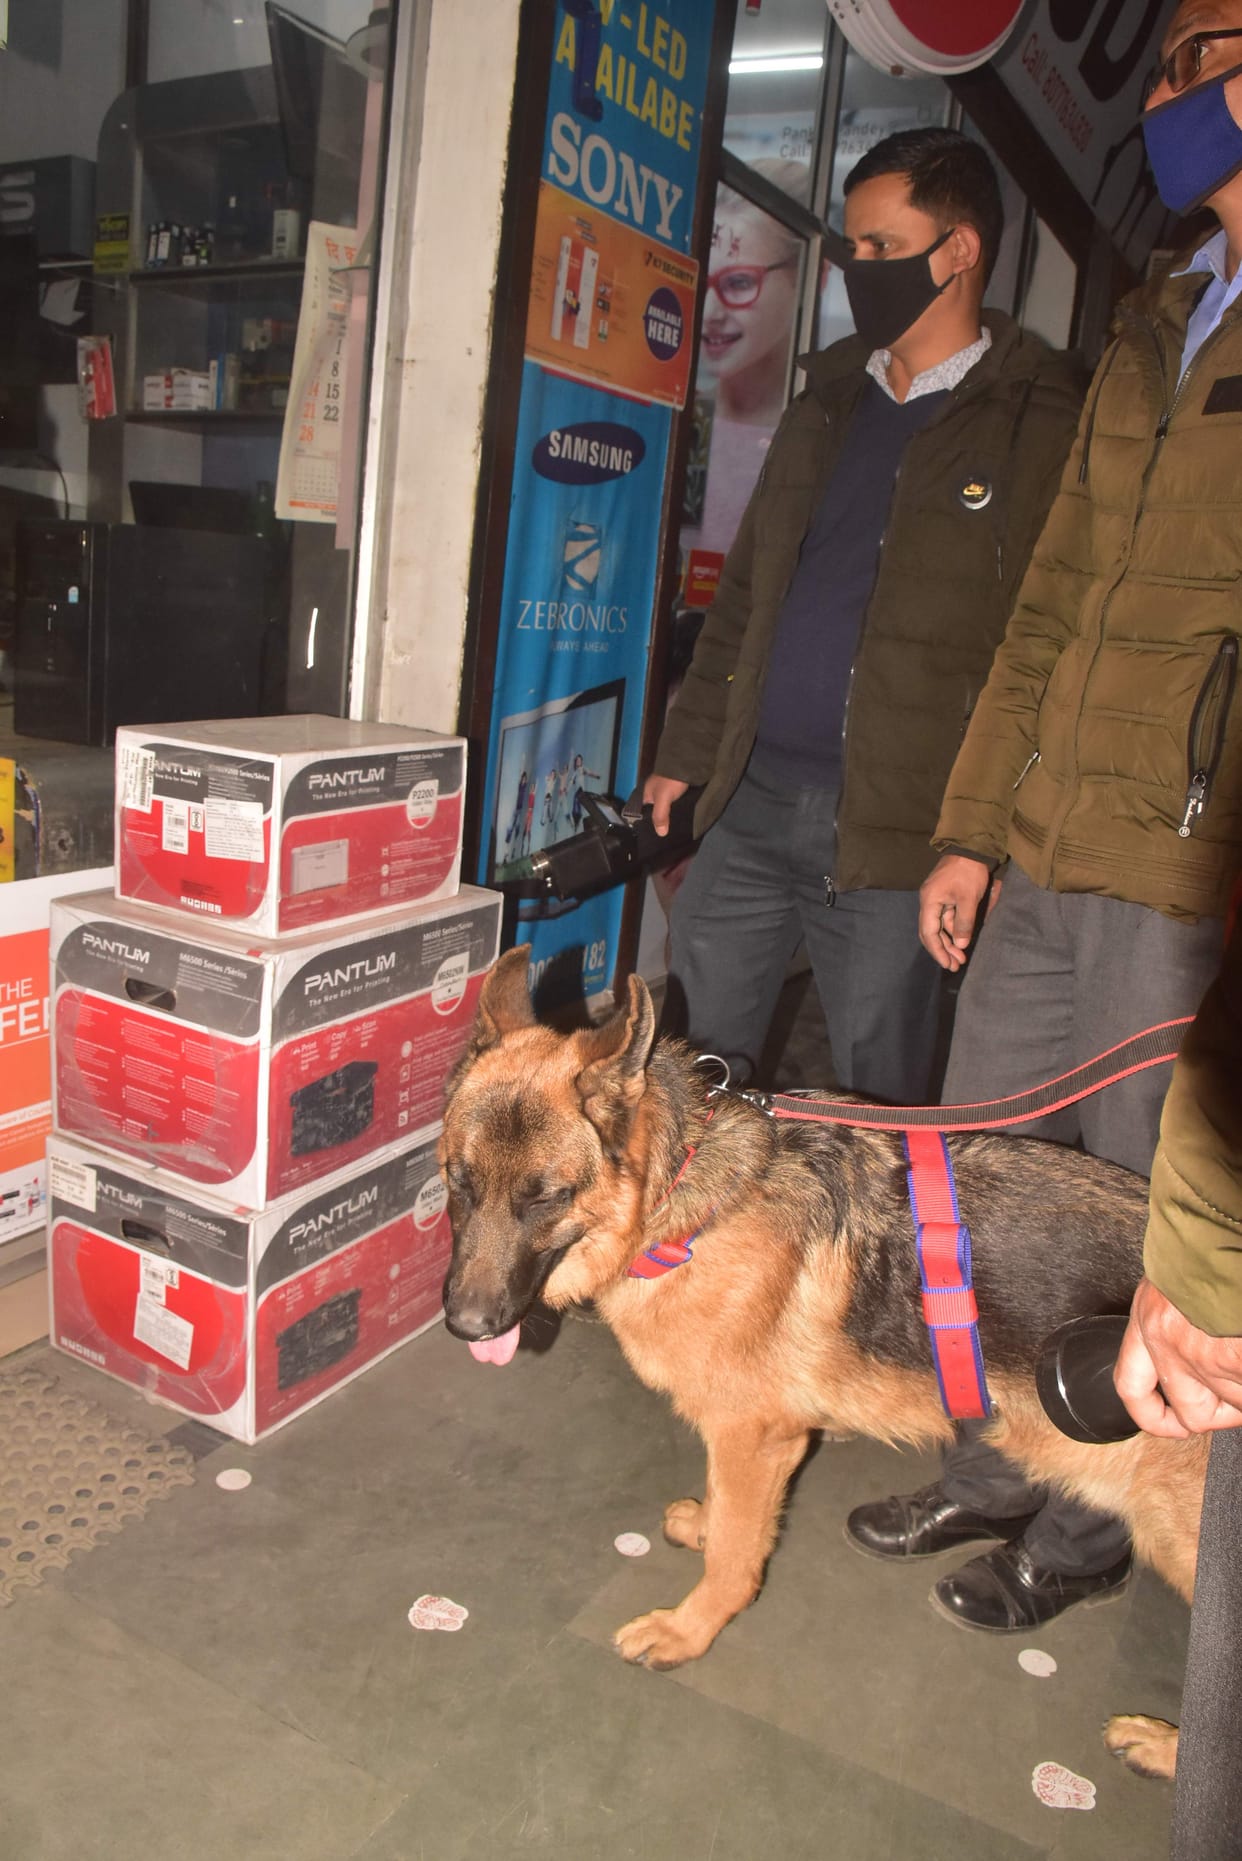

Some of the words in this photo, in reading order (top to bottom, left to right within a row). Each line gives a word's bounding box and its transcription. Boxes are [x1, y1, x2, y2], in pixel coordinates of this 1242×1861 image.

[555, 13, 695, 152] AAILABE
[547, 112, 682, 239] SONY
[662, 261, 695, 285] SECURITY
[648, 304, 682, 329] AVAILABLE
[647, 319, 680, 348] HERE
[331, 361, 340, 377] 8
[326, 383, 340, 400] 15
[303, 402, 315, 419] 21
[323, 405, 339, 422] 22
[299, 425, 314, 442] 28
[548, 430, 633, 474] SAMSUNG
[516, 600, 627, 633] ZEBRONICS
[154, 760, 201, 779] ANTUM
[308, 767, 385, 790] PANTUM
[312, 793, 323, 801] The
[412, 788, 435, 800] P2200
[82, 932, 150, 964] PANTUM
[203, 958, 223, 973] Series
[304, 952, 396, 996] PANTUM
[323, 993, 338, 1003] New
[341, 988, 352, 998] Era
[364, 975, 391, 990] Printing
[0, 996, 50, 1043] FE
[97, 1180, 142, 1209] NTUM
[288, 1184, 378, 1246] PANTUM
